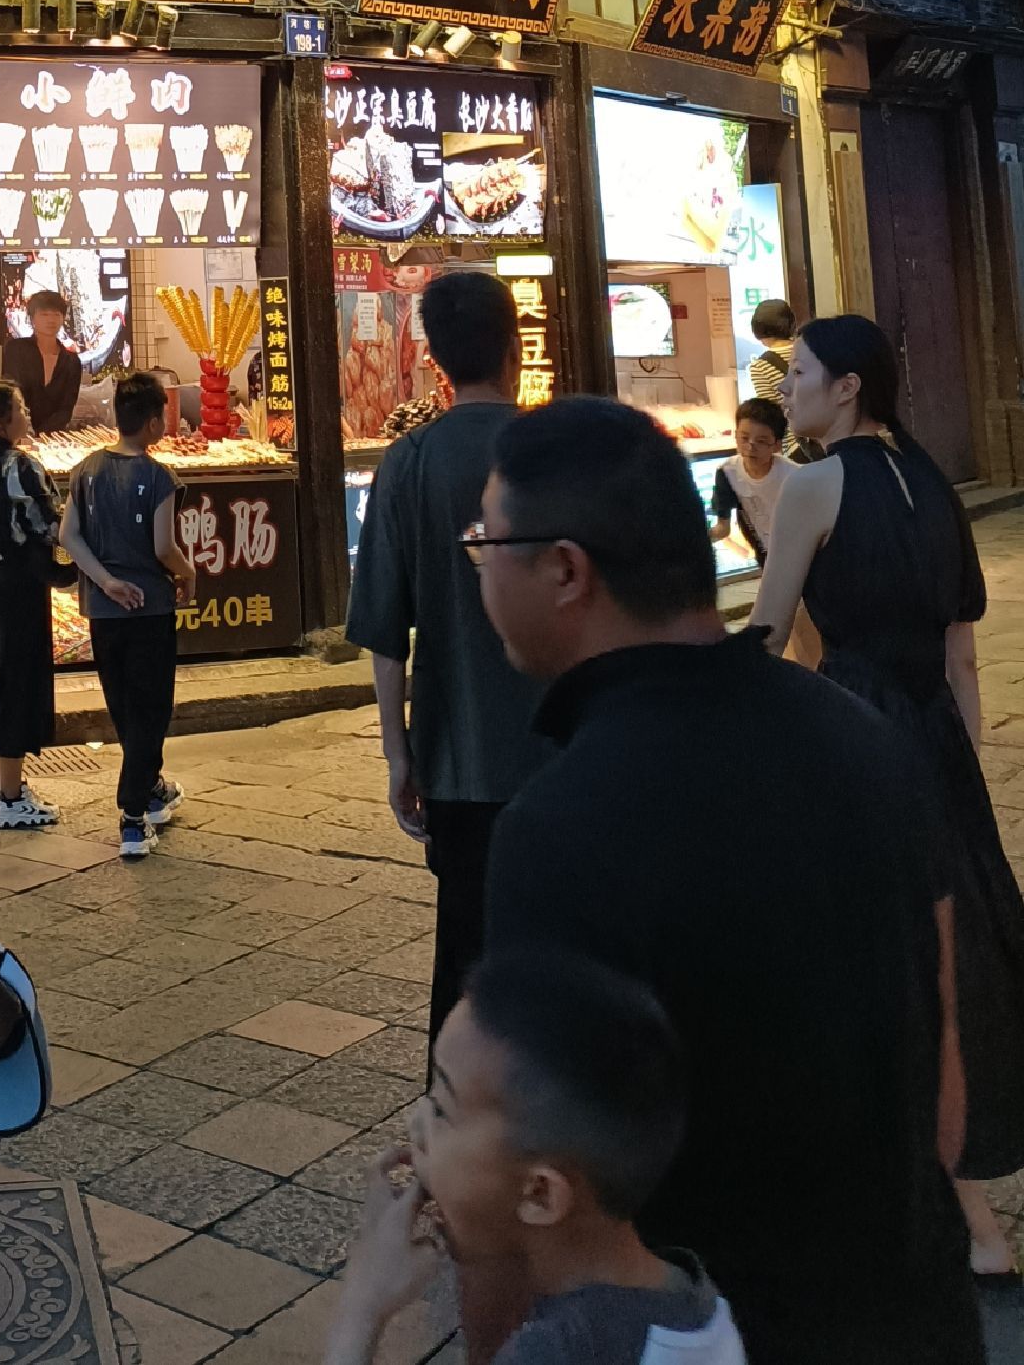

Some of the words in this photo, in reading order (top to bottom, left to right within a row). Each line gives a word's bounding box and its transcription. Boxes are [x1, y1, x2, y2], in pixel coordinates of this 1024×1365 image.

[294, 34, 321, 52] 198-1
[20, 67, 193, 120] 小鲜肉
[265, 287, 289, 393] 绝味烤面筋
[511, 279, 555, 407] 臭豆腐
[178, 495, 277, 574] 鸭肠
